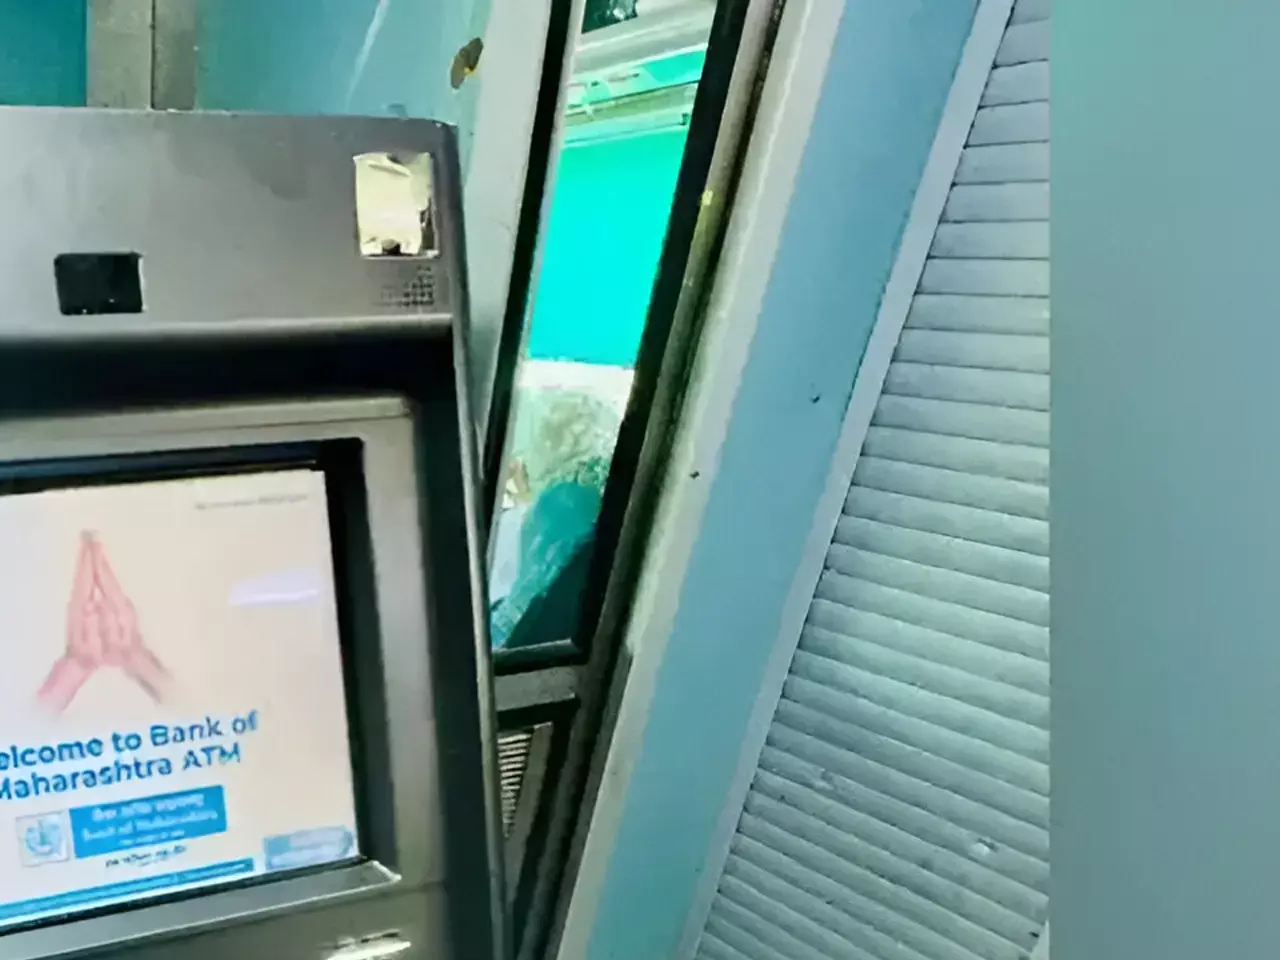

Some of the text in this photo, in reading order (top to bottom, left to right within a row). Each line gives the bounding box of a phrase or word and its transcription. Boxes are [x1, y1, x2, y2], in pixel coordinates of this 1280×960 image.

[112, 731, 142, 753] to
[150, 716, 221, 747] Bank
[231, 709, 258, 735] of
[182, 742, 242, 771] ATM
